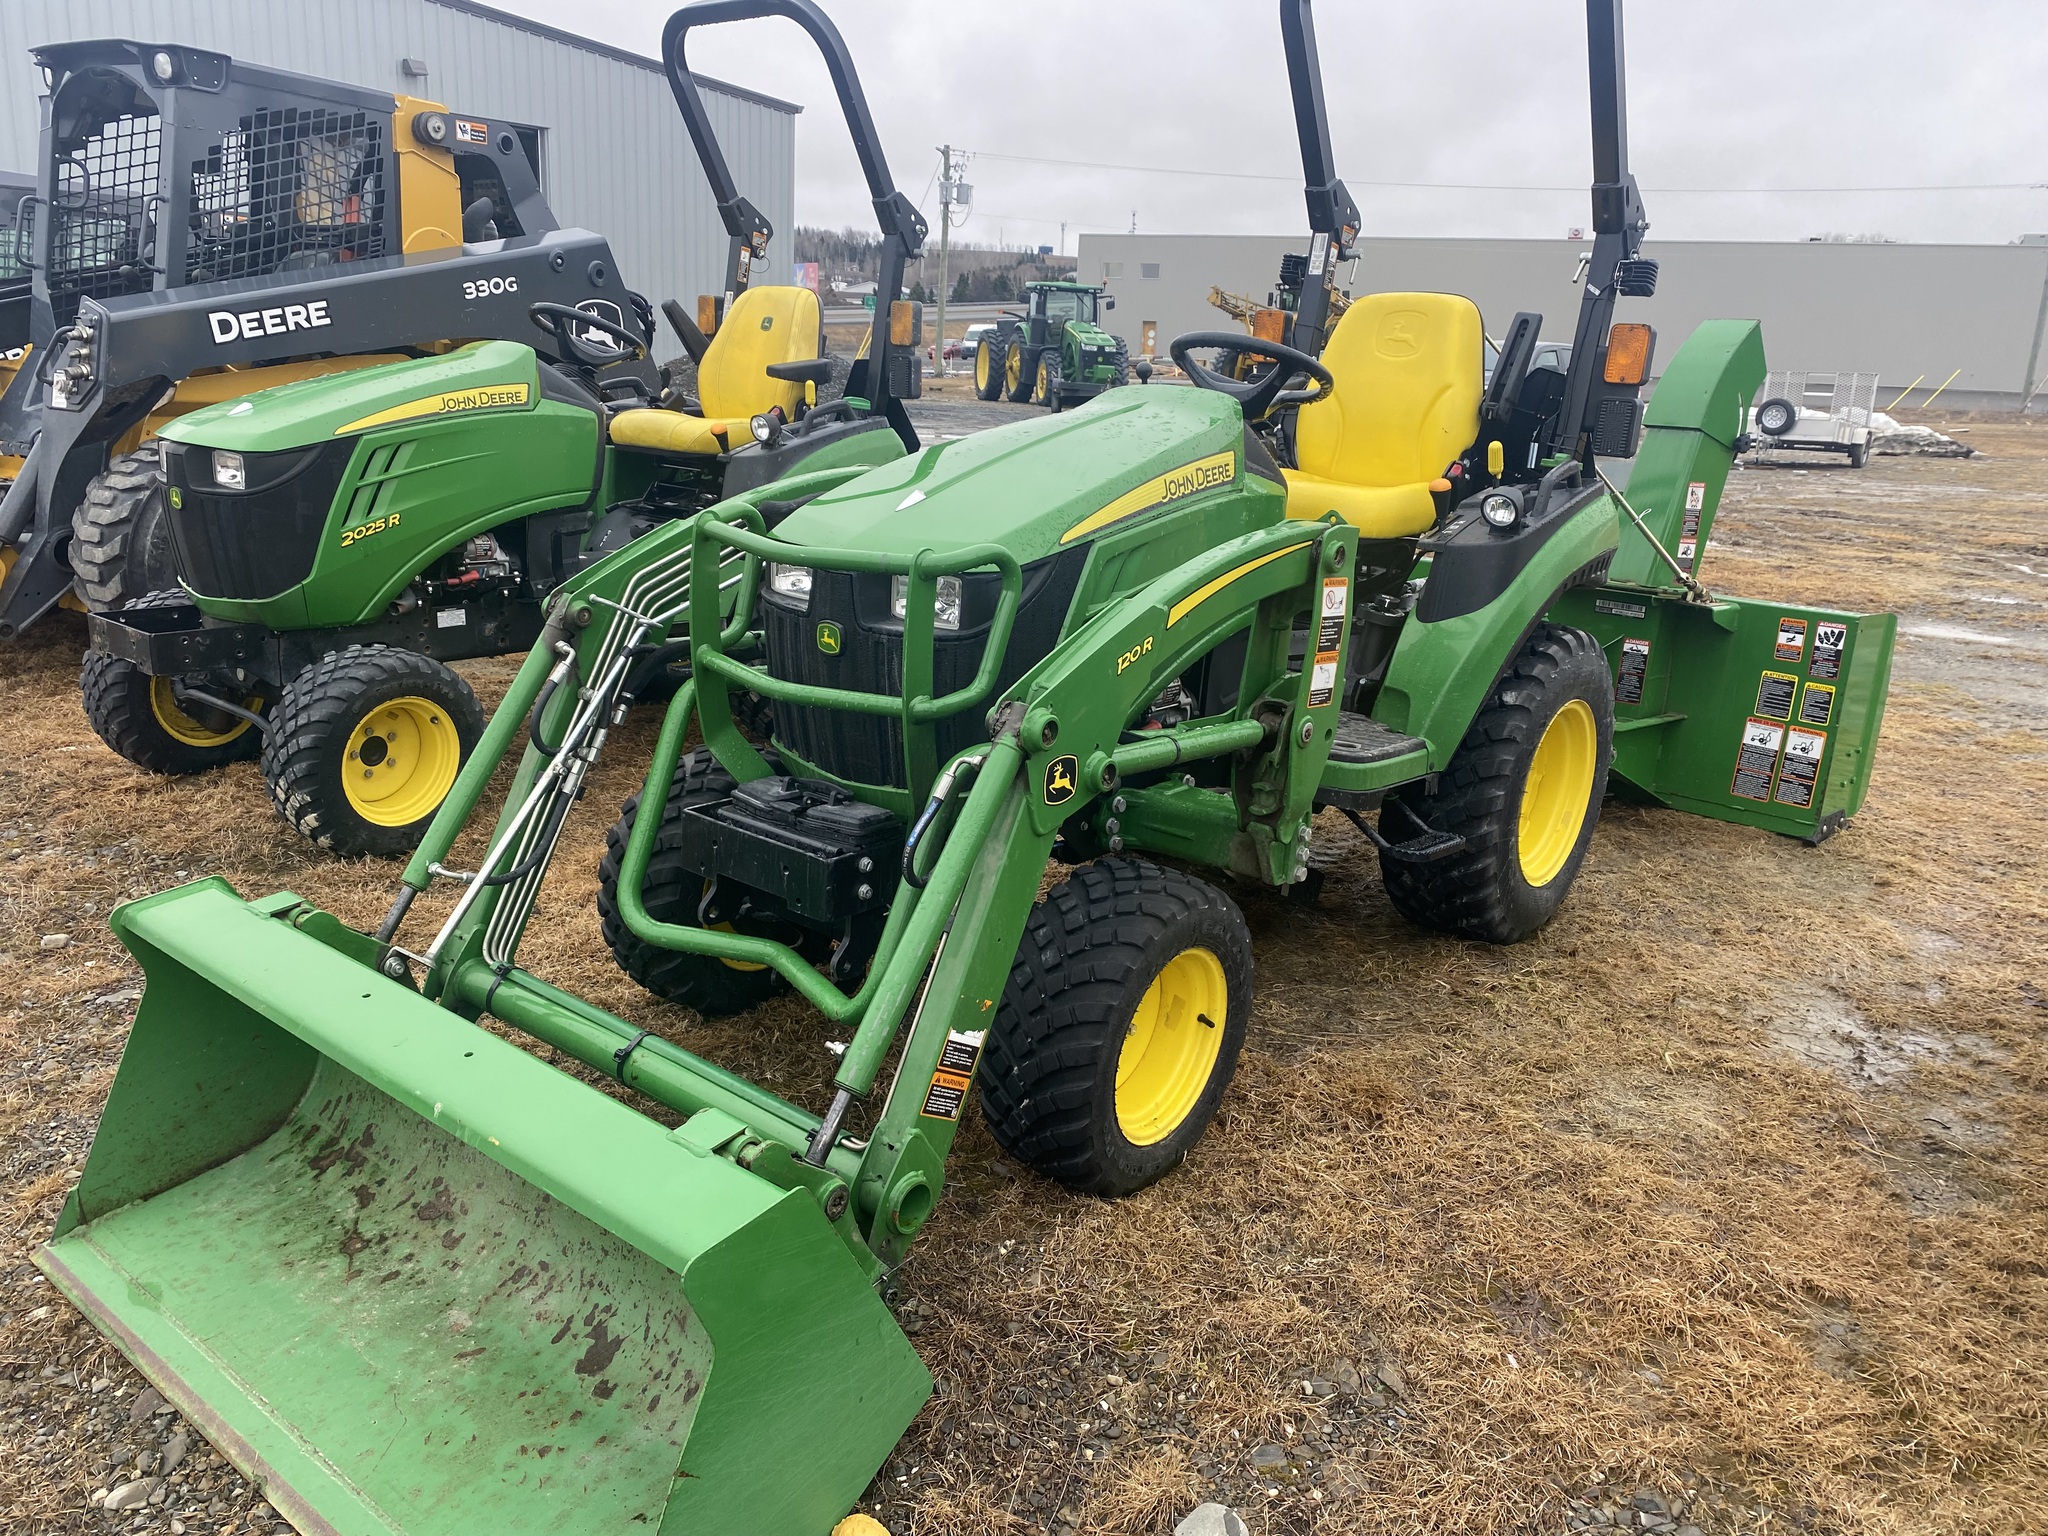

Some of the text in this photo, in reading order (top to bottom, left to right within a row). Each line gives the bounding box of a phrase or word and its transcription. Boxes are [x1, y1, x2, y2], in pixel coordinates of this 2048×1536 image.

[462, 276, 518, 300] 330G
[208, 300, 331, 344] DEERE
[439, 391, 523, 412] JOHN DEERE
[1161, 463, 1232, 501] JOHN DEERE
[341, 513, 401, 548] 2025 R
[1328, 578, 1347, 586] WARNING
[1824, 621, 1847, 629] DANGER
[1117, 635, 1154, 676] 120 R
[1768, 672, 1797, 681] ATTENTION
[1811, 684, 1834, 692] CAUTION
[1798, 728, 1823, 737] WARNING
[941, 1077, 965, 1088] WARNING
